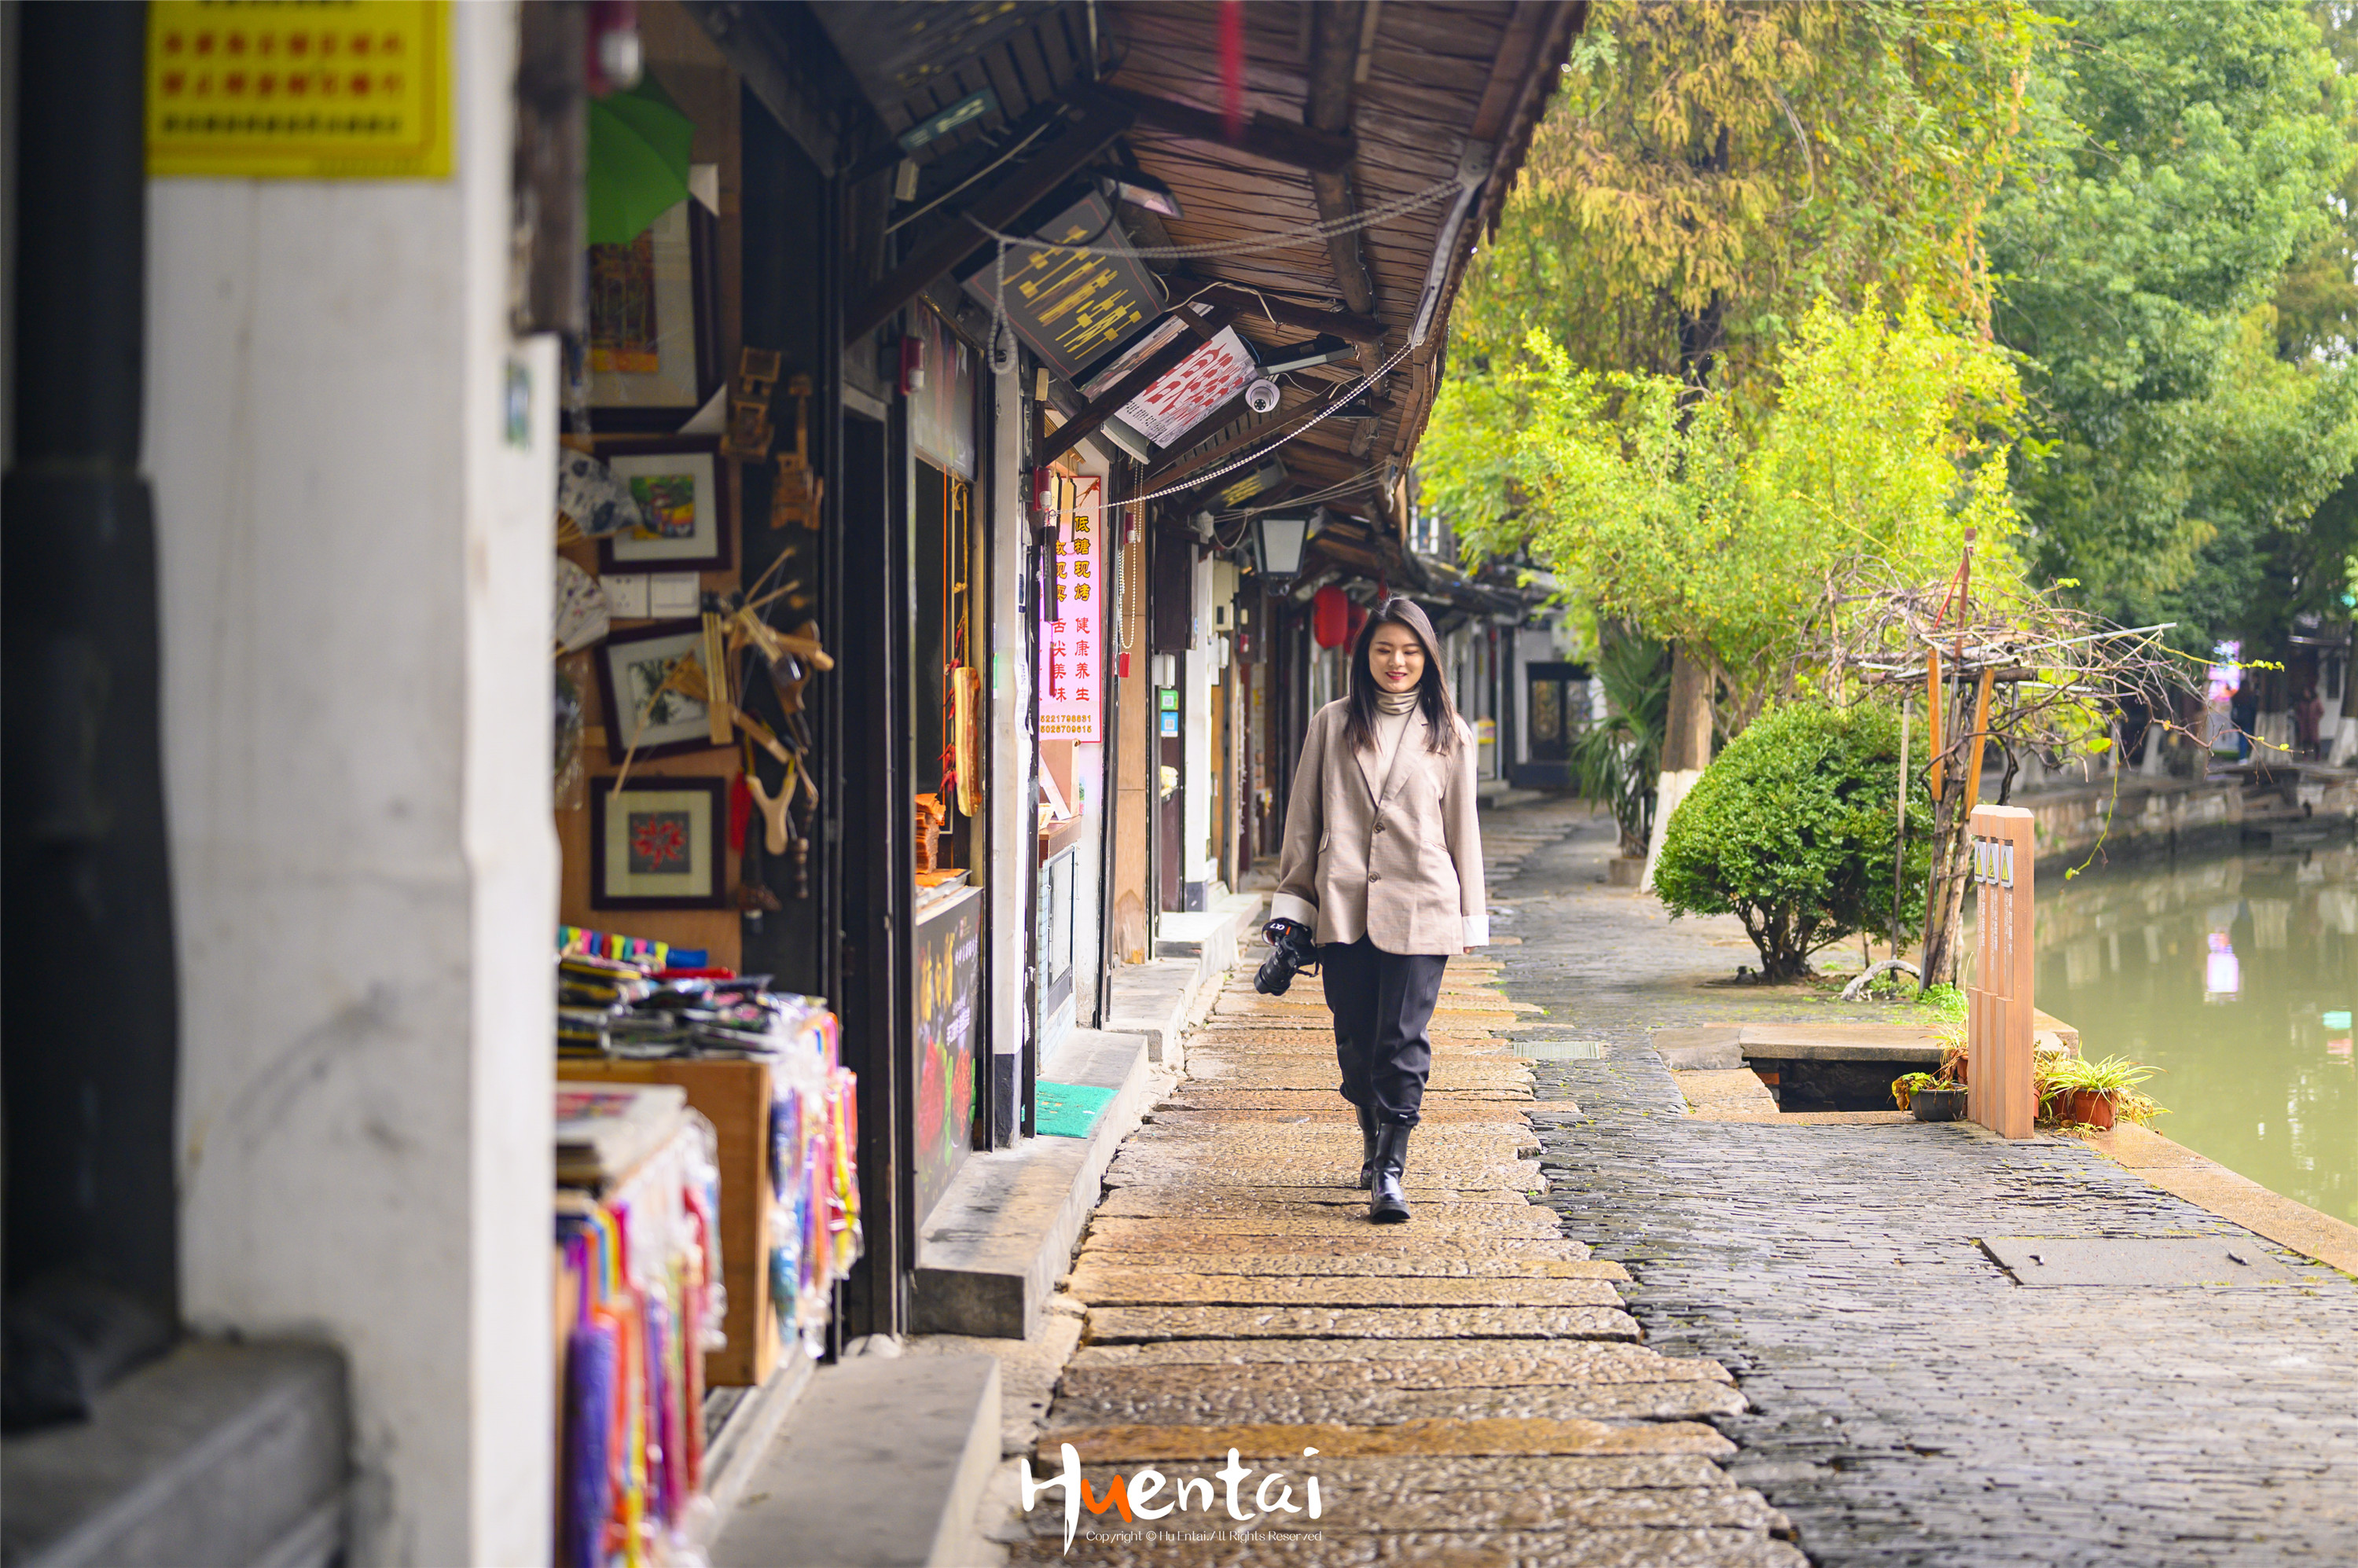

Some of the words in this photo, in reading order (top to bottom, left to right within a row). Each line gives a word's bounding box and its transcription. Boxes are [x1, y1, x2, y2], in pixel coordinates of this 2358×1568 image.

[1074, 516, 1091, 601] 低糖现烤
[1074, 617, 1090, 702] 健康养生
